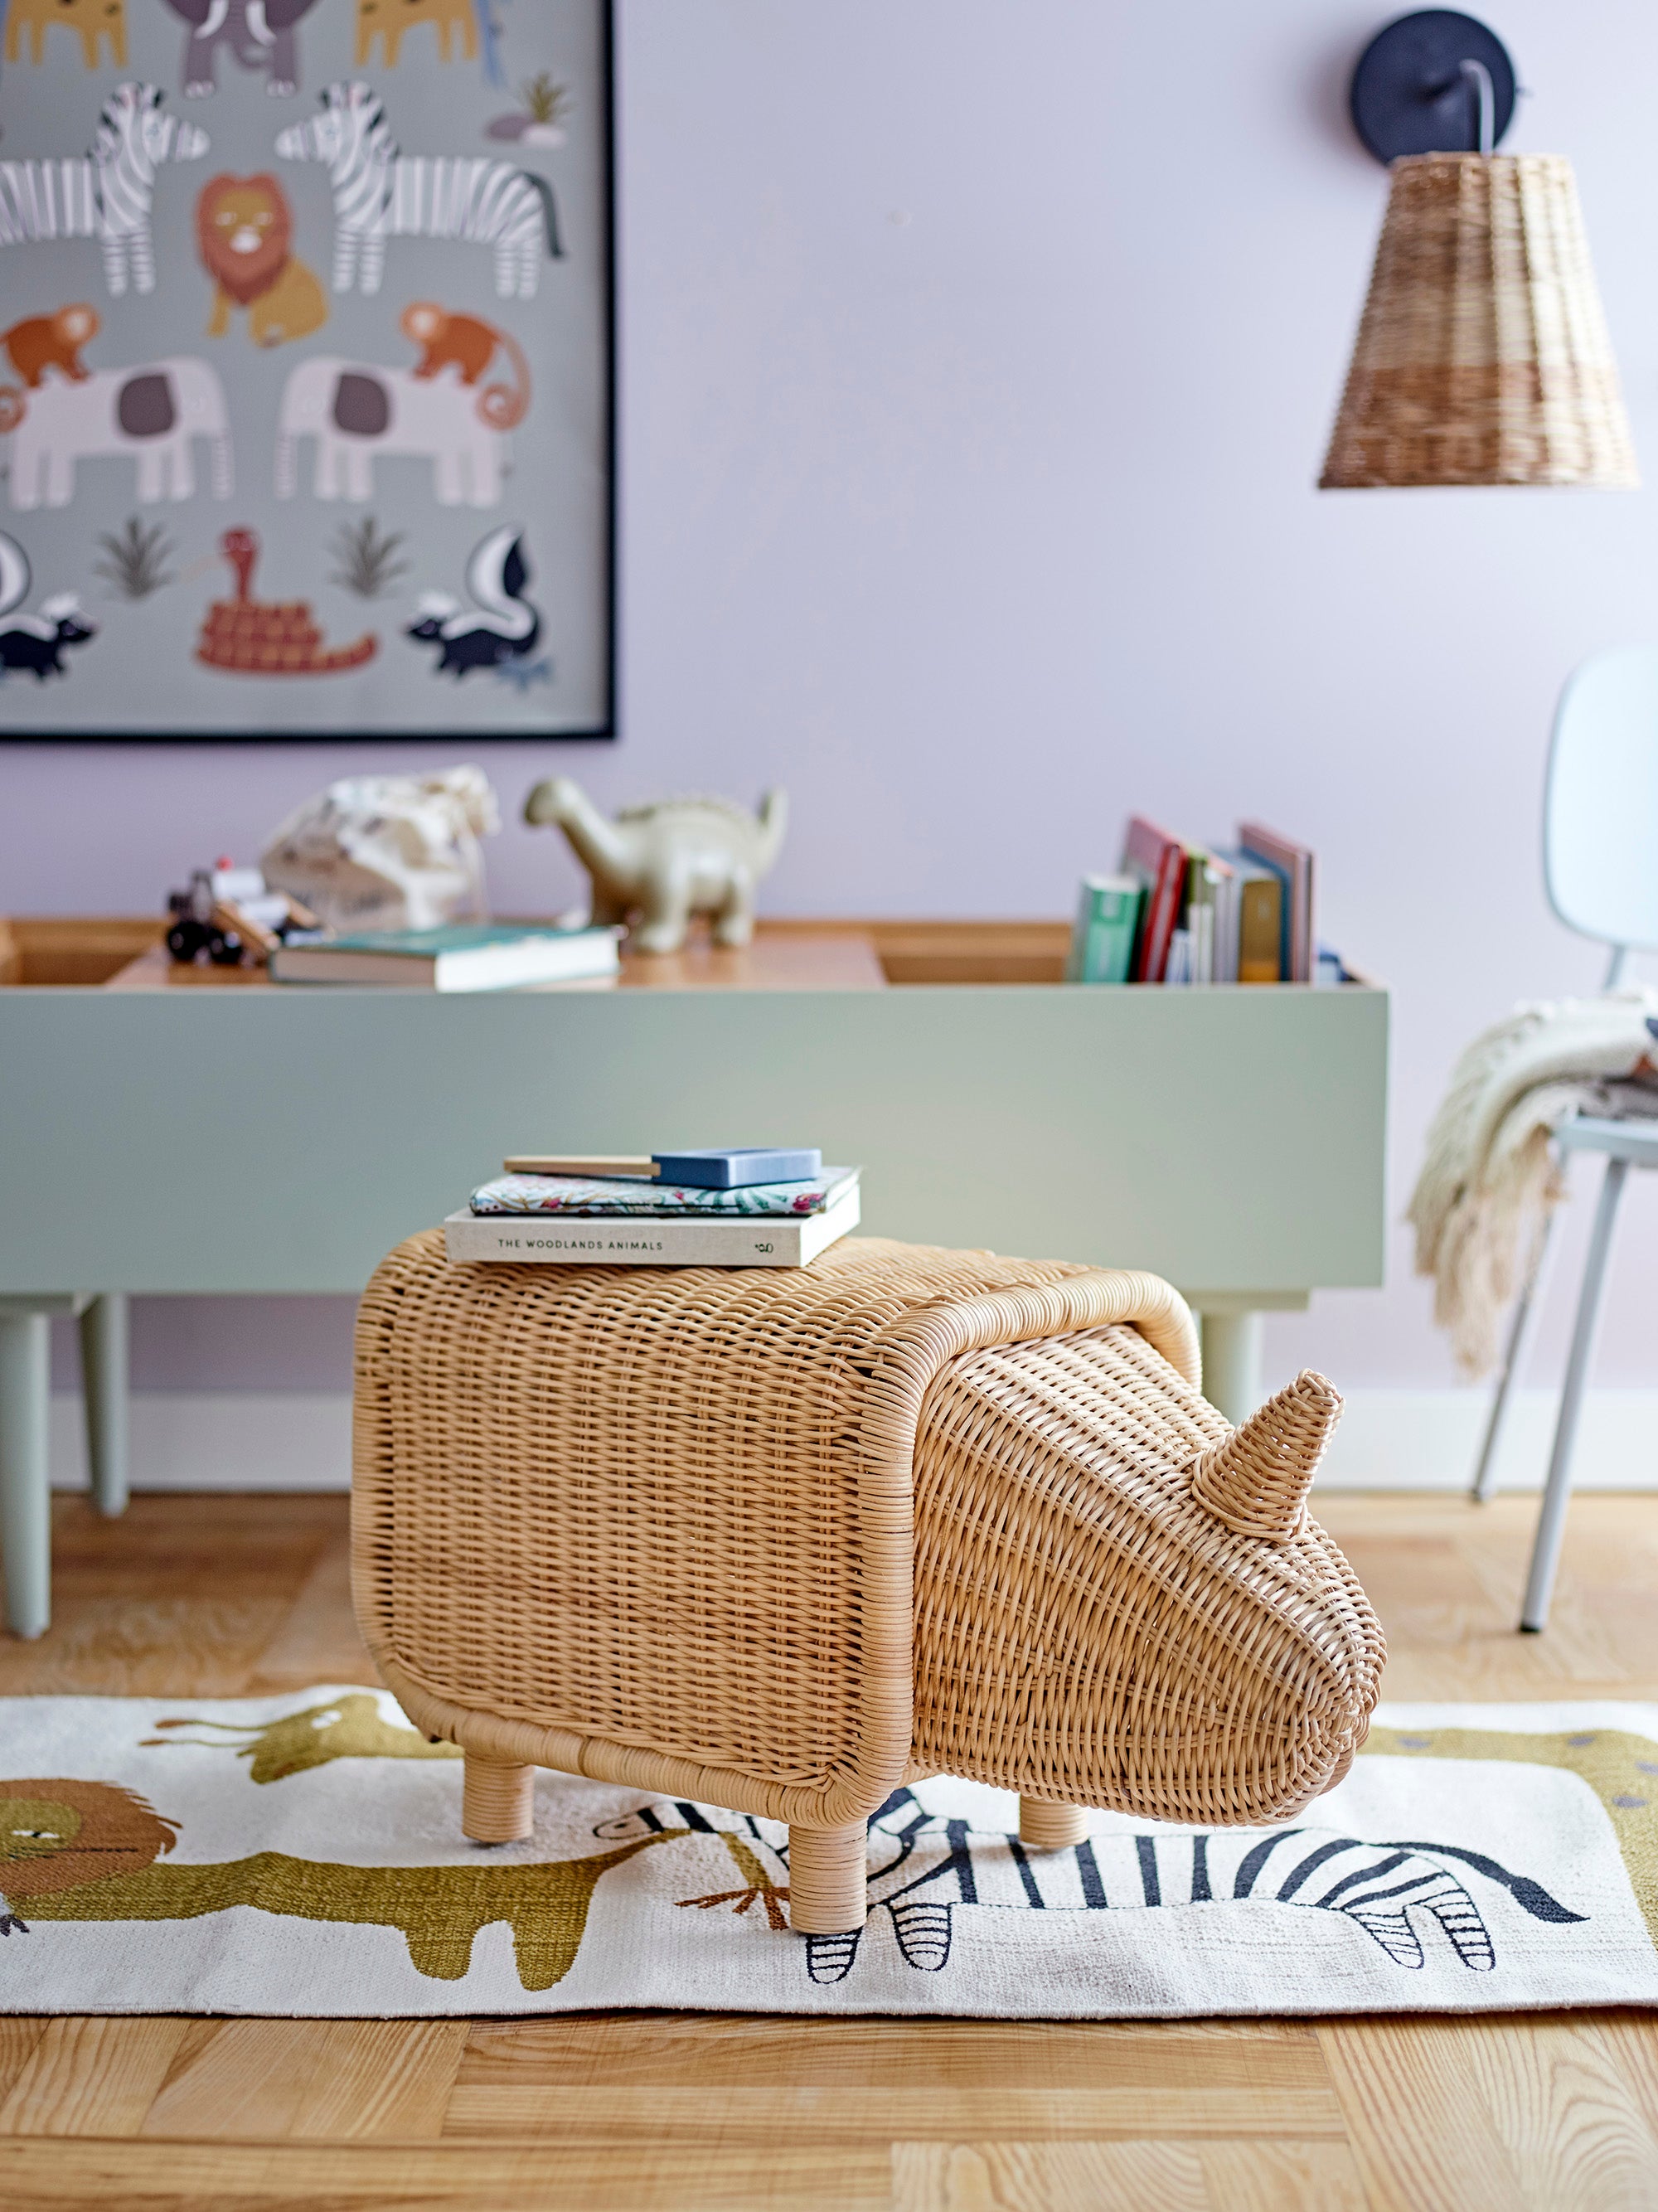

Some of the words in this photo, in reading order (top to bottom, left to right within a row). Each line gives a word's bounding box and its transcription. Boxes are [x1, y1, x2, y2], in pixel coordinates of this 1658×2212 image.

[498, 1239, 521, 1248] THE
[526, 1239, 603, 1249] WOODLANDS
[608, 1241, 663, 1250] ANIMALS
